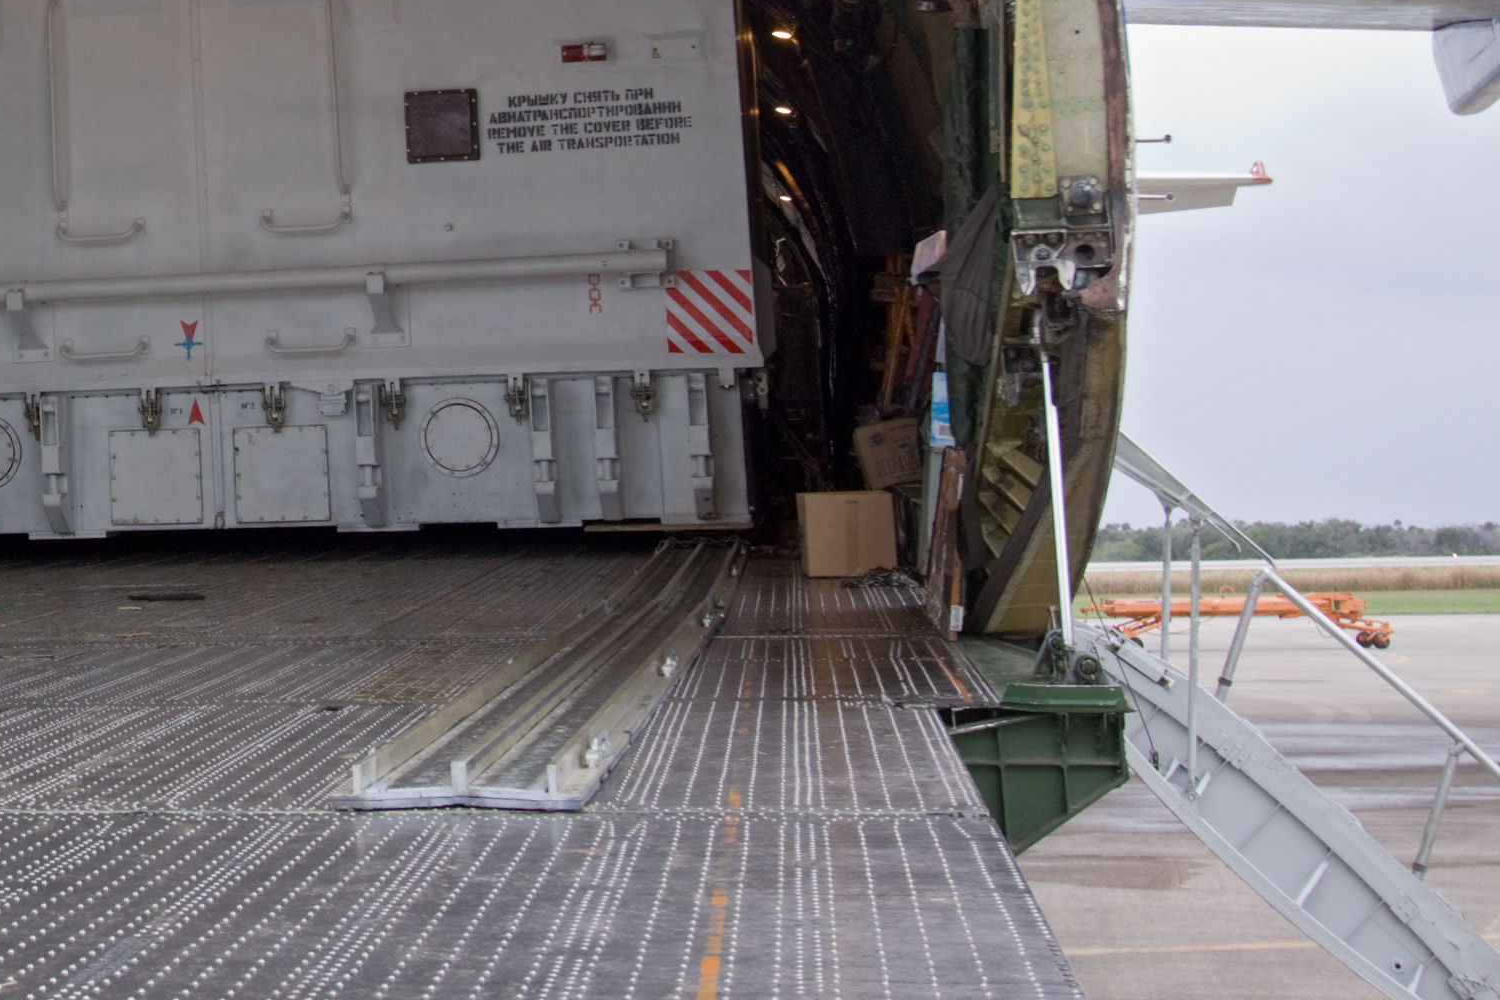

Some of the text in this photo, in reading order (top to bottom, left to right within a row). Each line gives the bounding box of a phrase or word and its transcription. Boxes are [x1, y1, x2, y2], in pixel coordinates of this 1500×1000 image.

[508, 88, 653, 108] КРЫШКУ СНЯТЬ ПРИ
[488, 116, 692, 139] REMOVE THE COVER BEFORE
[497, 133, 679, 154] THE AIR TRANSPORTATION
